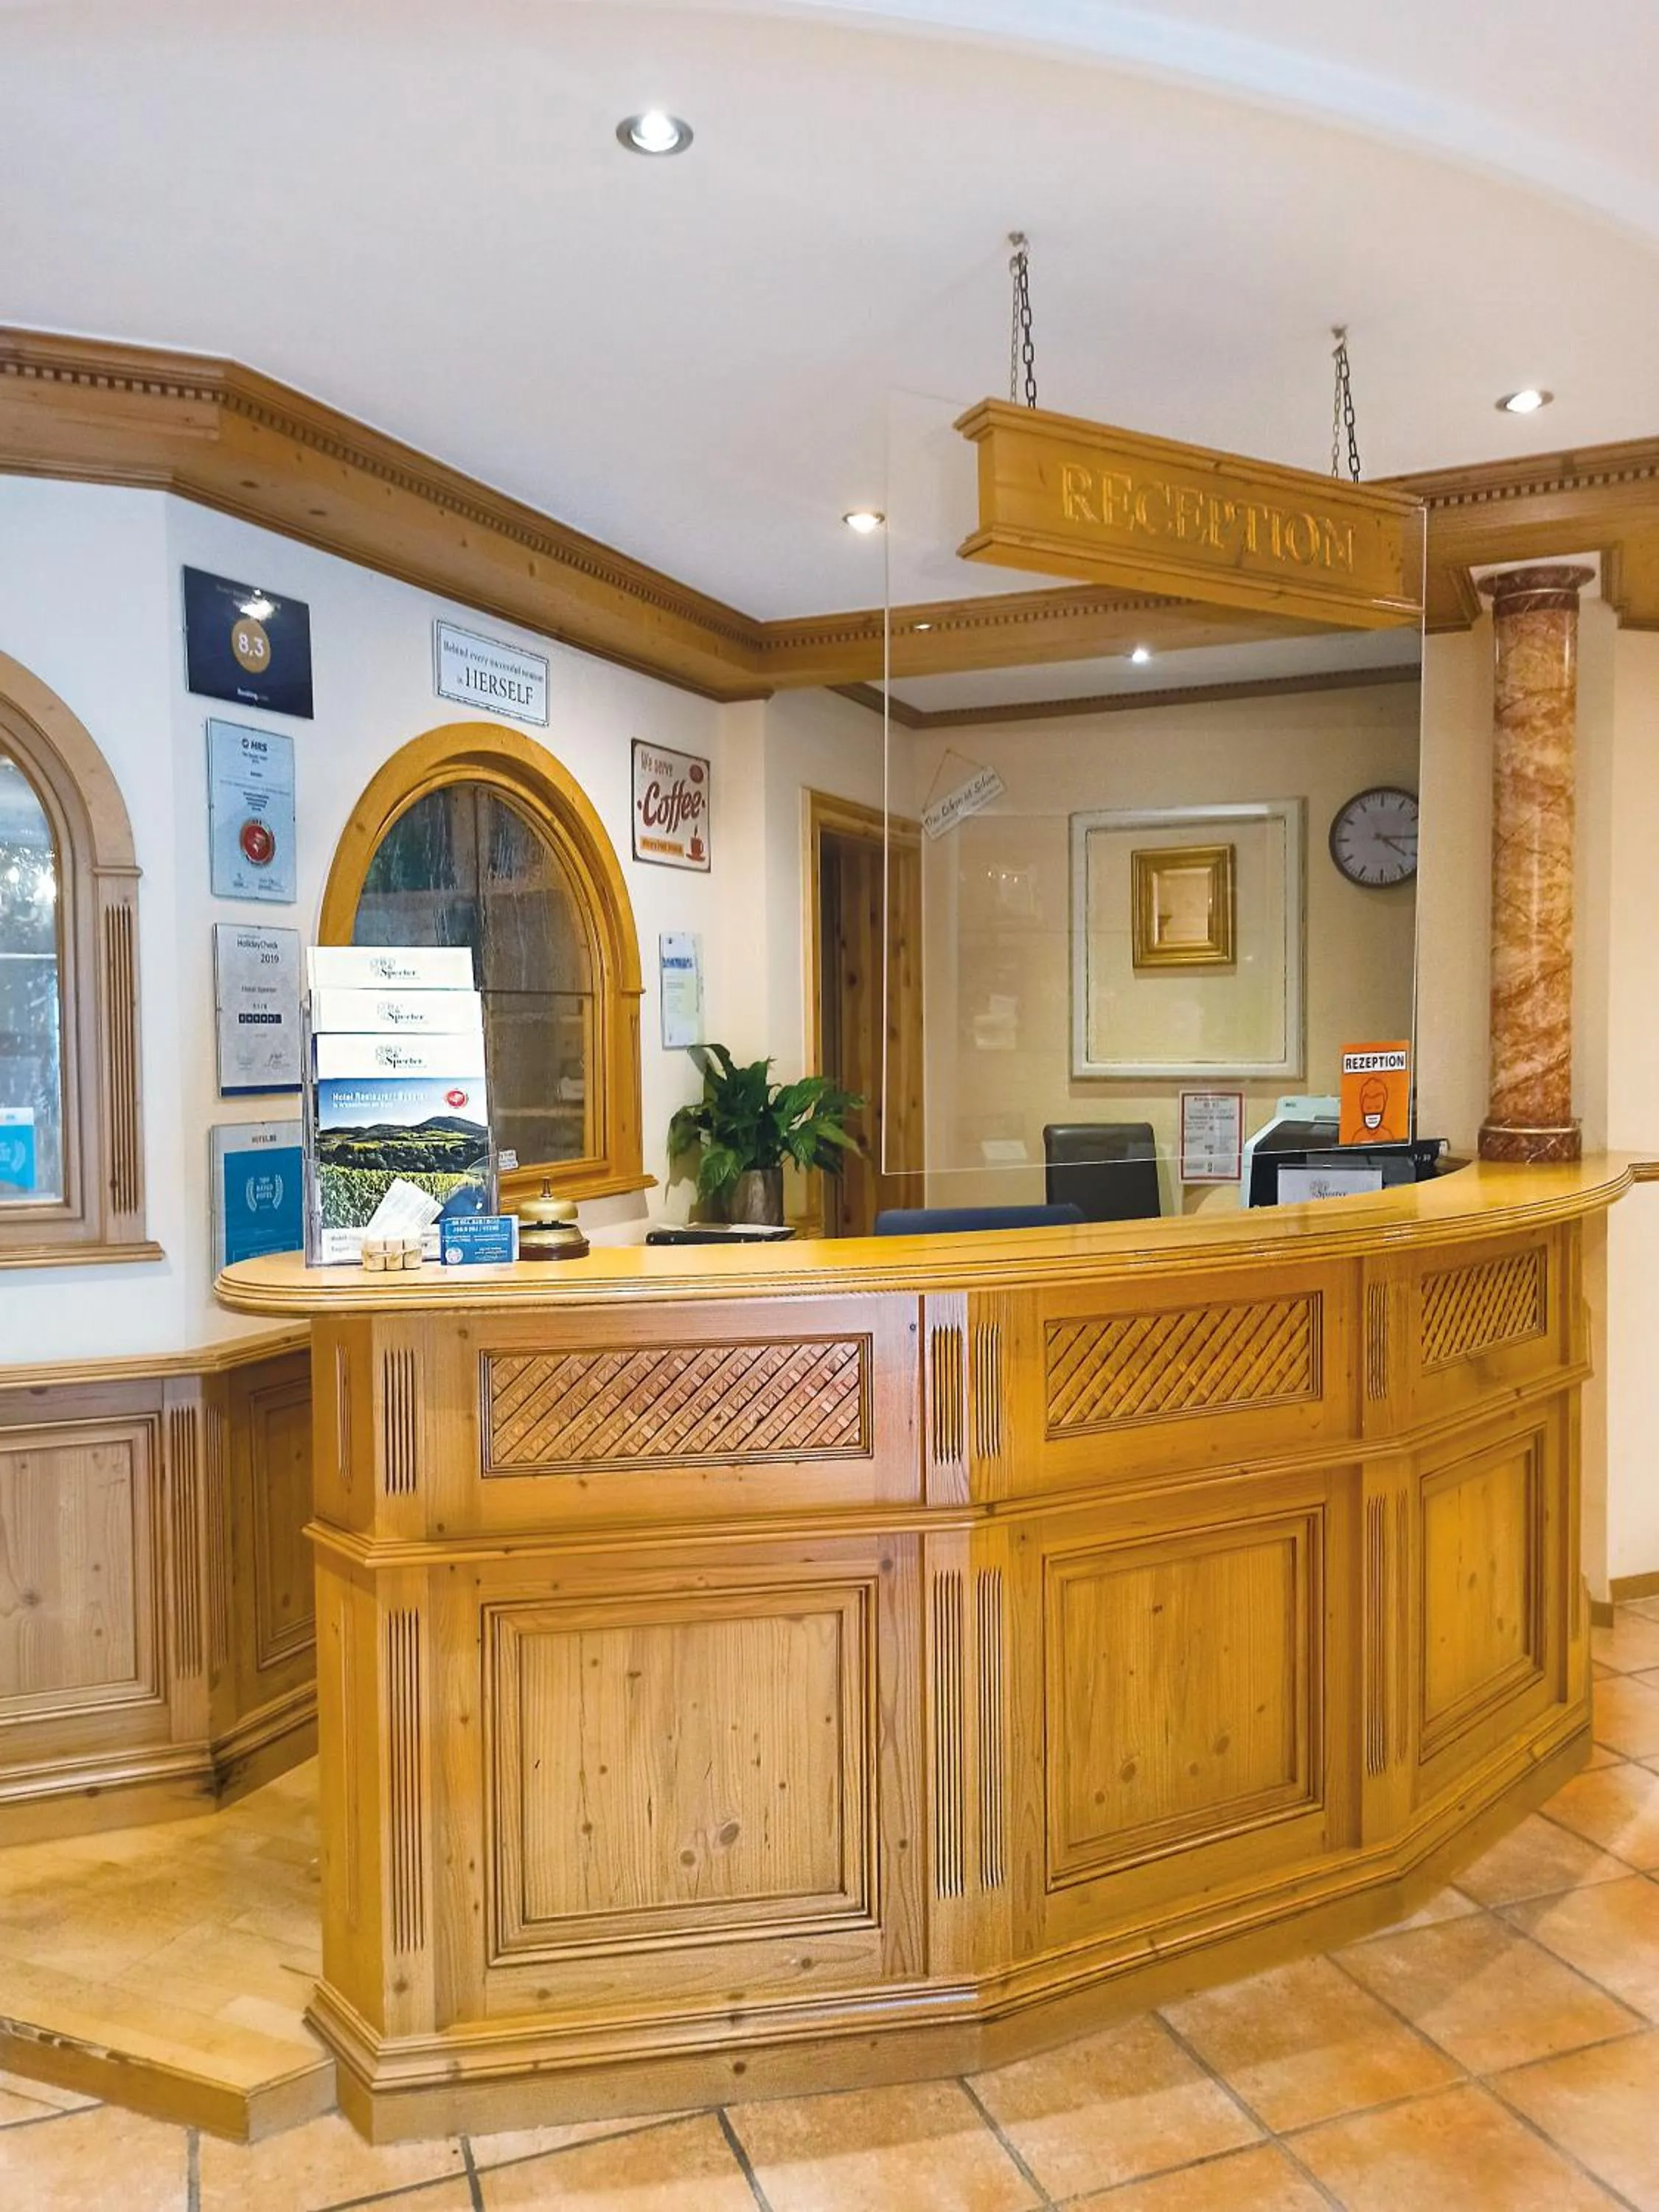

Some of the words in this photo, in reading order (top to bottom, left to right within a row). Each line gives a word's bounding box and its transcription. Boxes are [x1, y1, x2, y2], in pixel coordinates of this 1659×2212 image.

[1060, 462, 1358, 573] RECEPTION
[238, 633, 264, 658] 8,3
[465, 666, 533, 706] HERSELF
[643, 779, 703, 835] Coffee
[260, 953, 279, 964] 2019
[1345, 1055, 1405, 1070] REZEPTION
